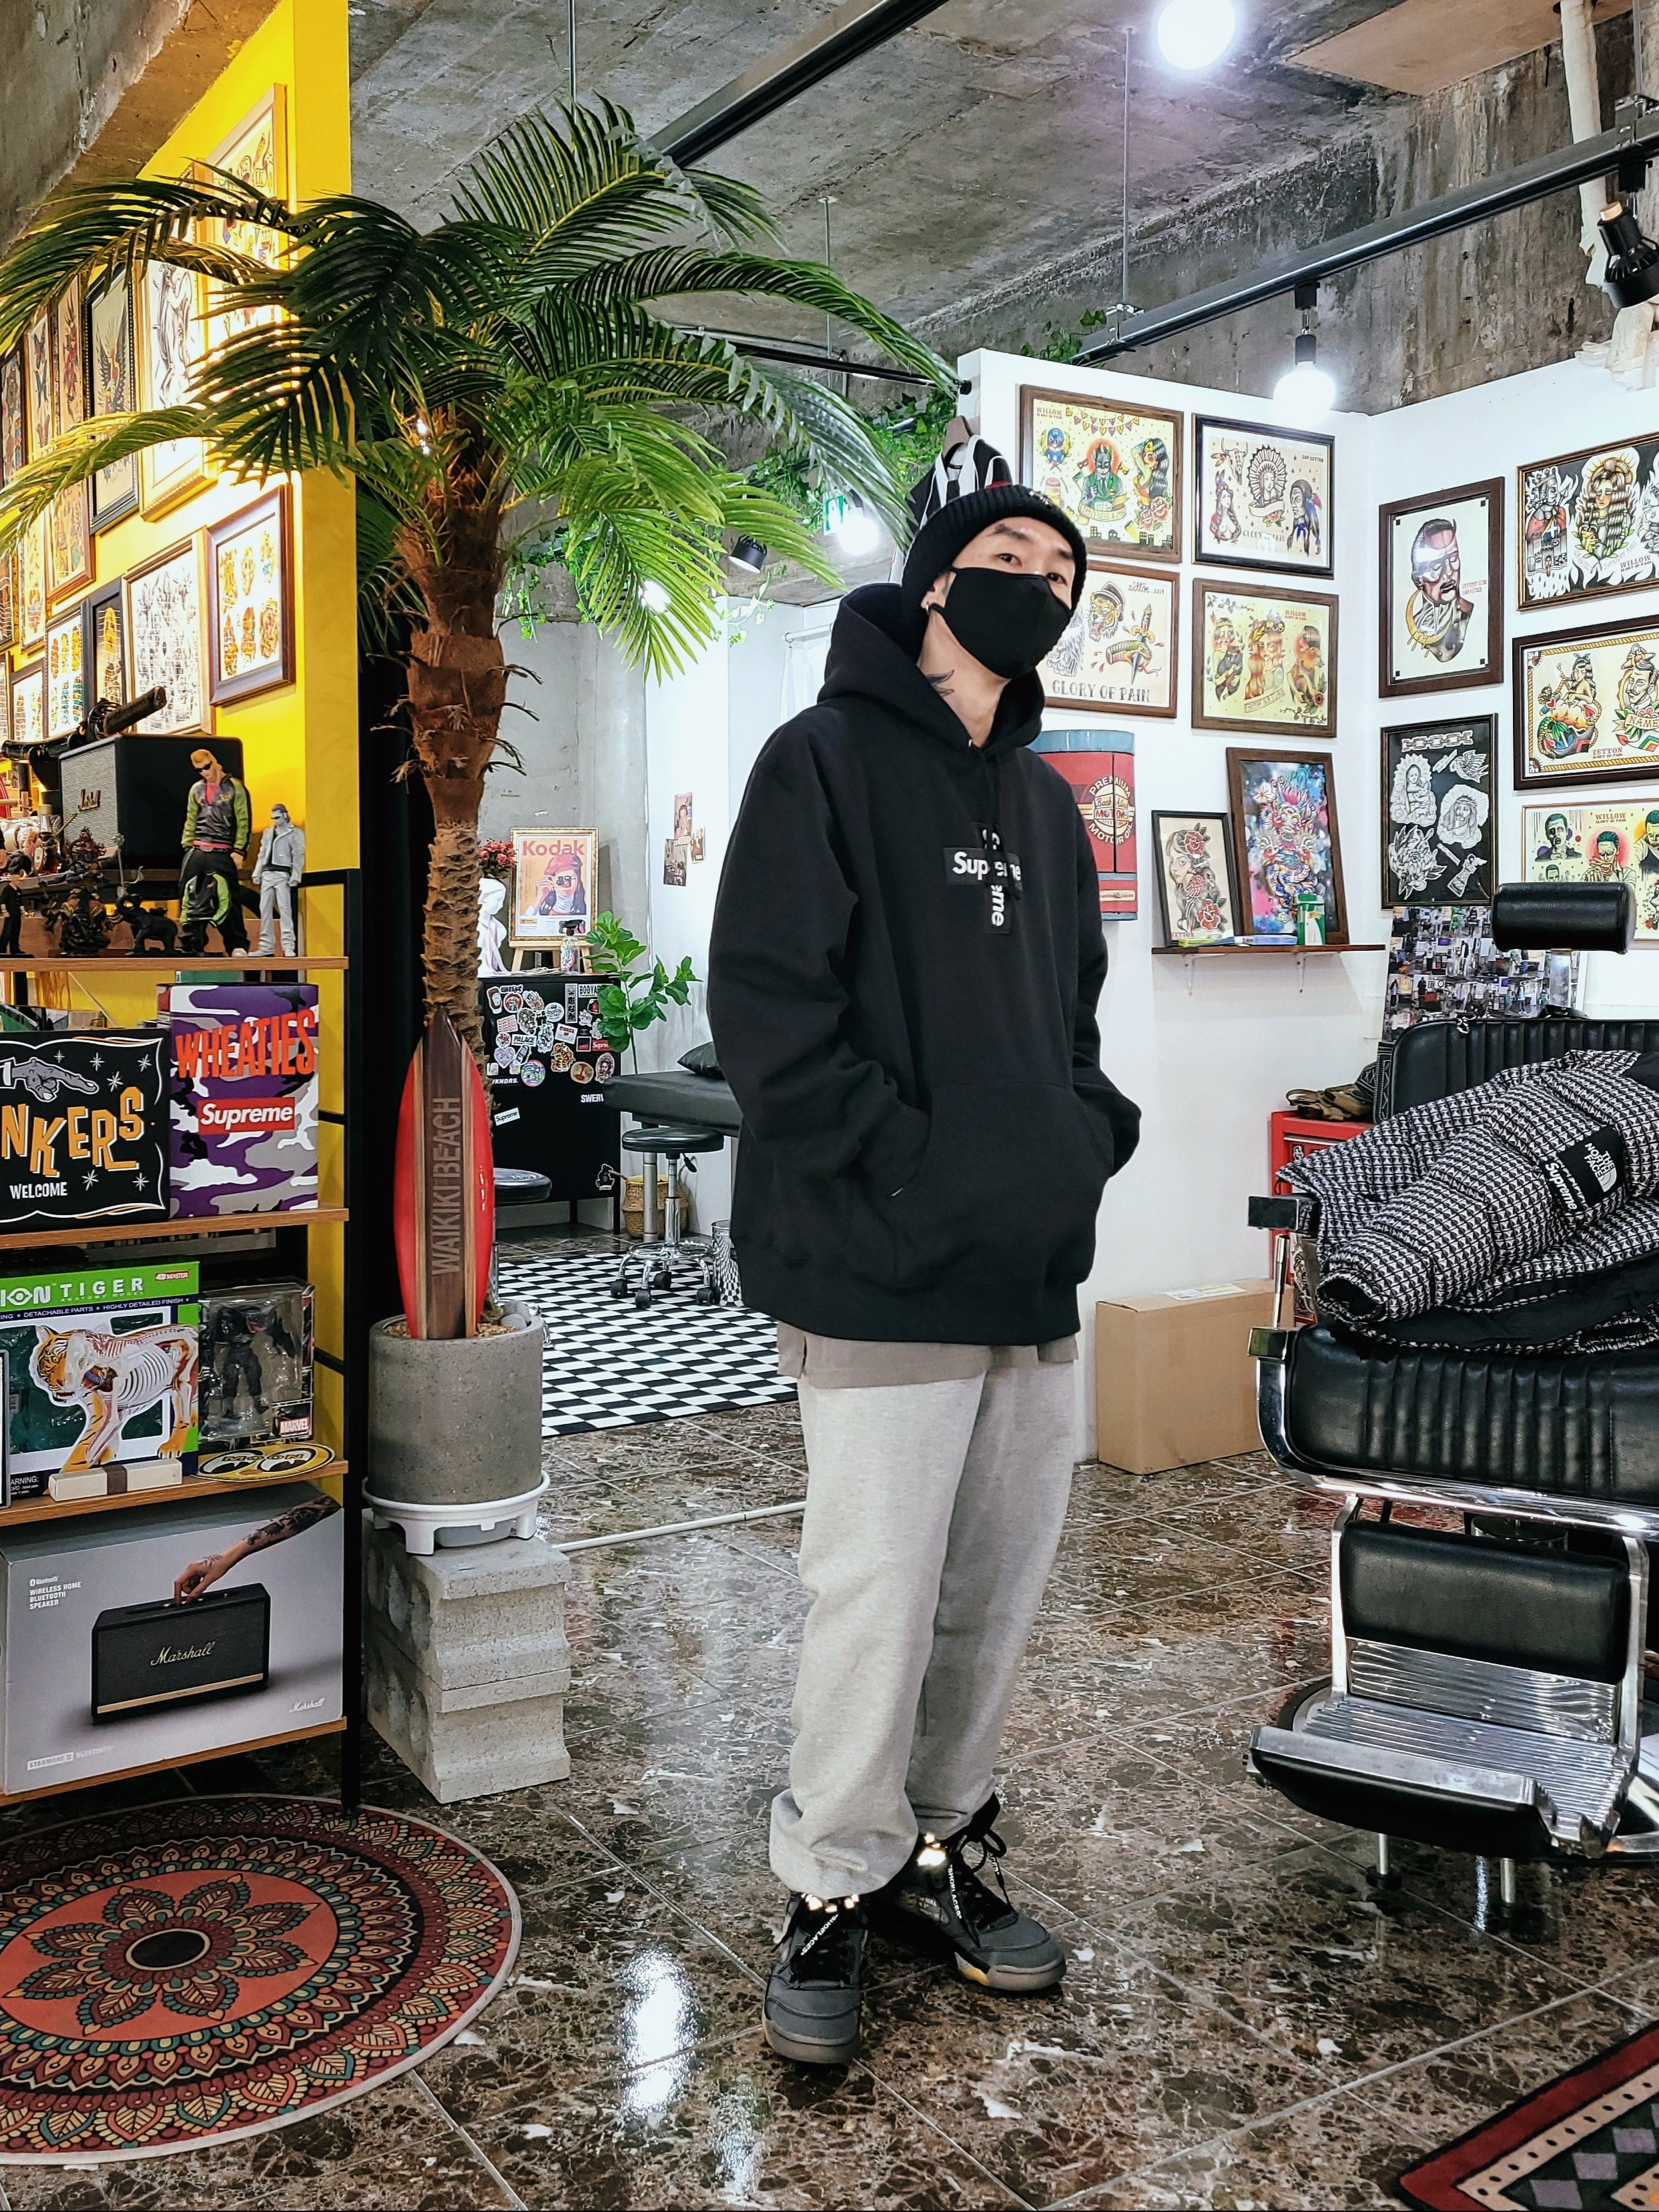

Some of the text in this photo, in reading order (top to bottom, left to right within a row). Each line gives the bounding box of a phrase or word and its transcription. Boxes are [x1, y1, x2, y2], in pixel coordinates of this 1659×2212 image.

[1620, 555, 1651, 568] WILLOW
[1052, 680, 1150, 703] GLORY OF PAIN
[1629, 715, 1659, 728] NAME
[1593, 747, 1622, 755] ZETTON
[1089, 776, 1130, 798] PREMIUM
[1088, 821, 1134, 845] MOTOR OIL
[523, 840, 585, 856] Kodak
[952, 851, 1021, 881] Supeme
[175, 1008, 316, 1079] WHEATIES
[593, 1042, 608, 1050] Supre
[201, 1103, 293, 1130] Supreme
[496, 1110, 518, 1122] Supreme
[1, 1087, 145, 1178] NKERS
[1584, 1142, 1610, 1174] NORTH
[1584, 1154, 1604, 1178] FACE
[1602, 1150, 1614, 1170] THE
[9, 1181, 67, 1199] WELCOME
[432, 1098, 461, 1275] WAIKIKI BEACH
[1545, 1162, 1578, 1210] Supreme
[60, 1278, 143, 1298] TIGER
[60, 1294, 109, 1302] ANATOMY
[23, 1308, 70, 1318] DETACHABLE
[71, 1306, 93, 1315] PARTS
[128, 1300, 161, 1308] DETAILED
[280, 1419, 309, 1434] MARVEL
[222, 1453, 304, 1462] MOON
[29, 1581, 81, 1595] WIRELESS HOME
[29, 1591, 66, 1603] BLUETOOTH
[29, 1599, 59, 1609] SPEAKER
[151, 1641, 216, 1666] Marshall
[289, 1698, 326, 1713] Marshall
